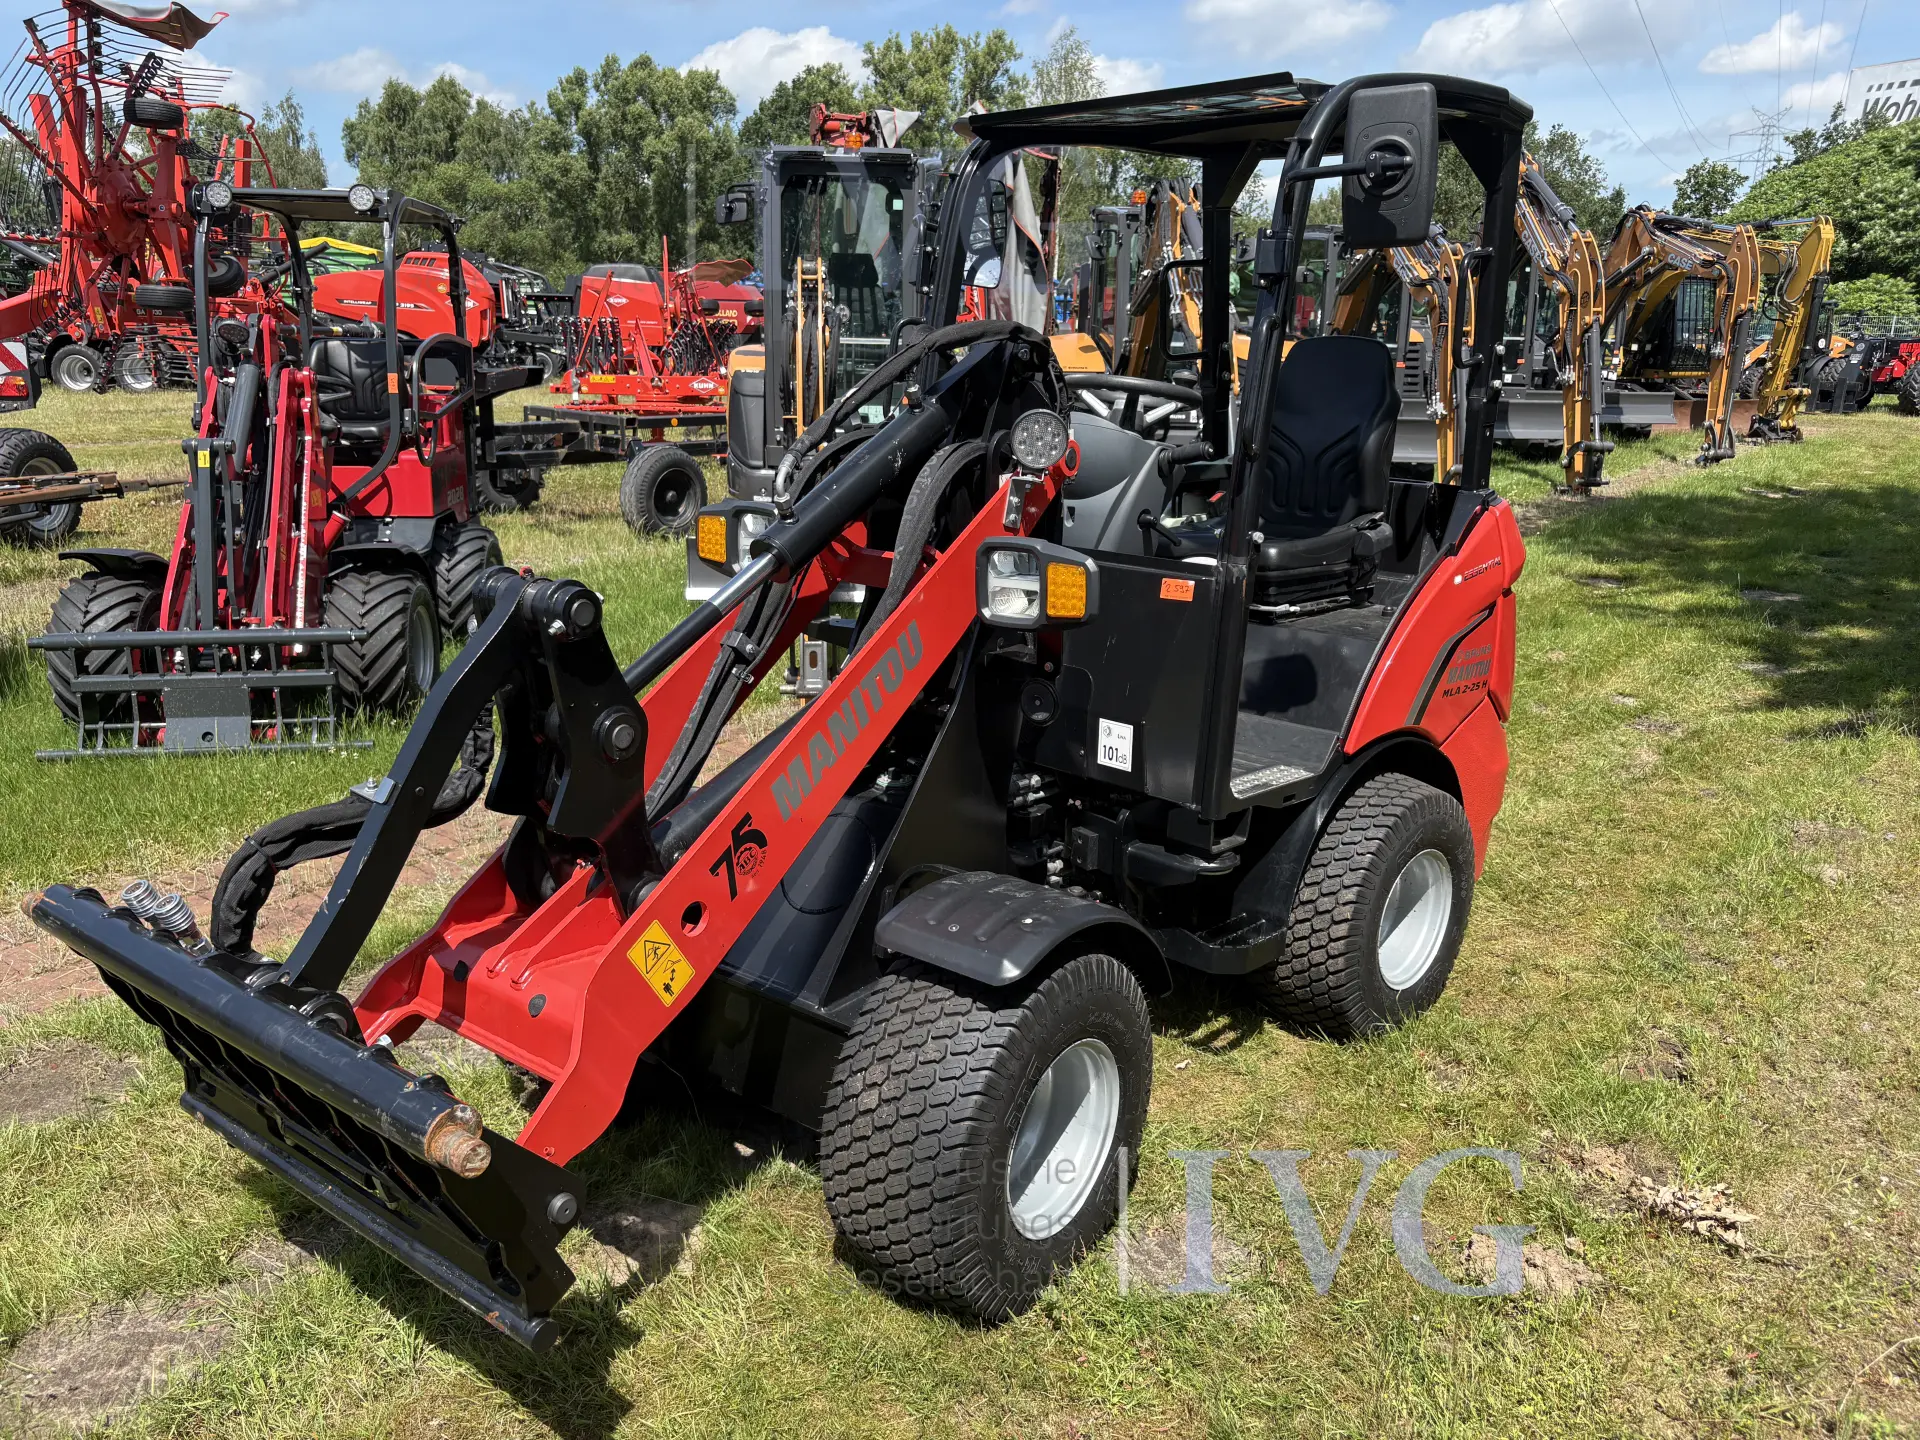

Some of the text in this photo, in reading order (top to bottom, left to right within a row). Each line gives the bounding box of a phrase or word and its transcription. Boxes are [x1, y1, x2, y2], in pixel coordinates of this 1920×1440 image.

[1667, 253, 1694, 270] CASE
[1464, 556, 1501, 581] ESSENTIAL
[1446, 658, 1492, 684] MANITOU
[1442, 679, 1488, 699] MLA 2-25 H
[770, 620, 924, 823] MANITOU
